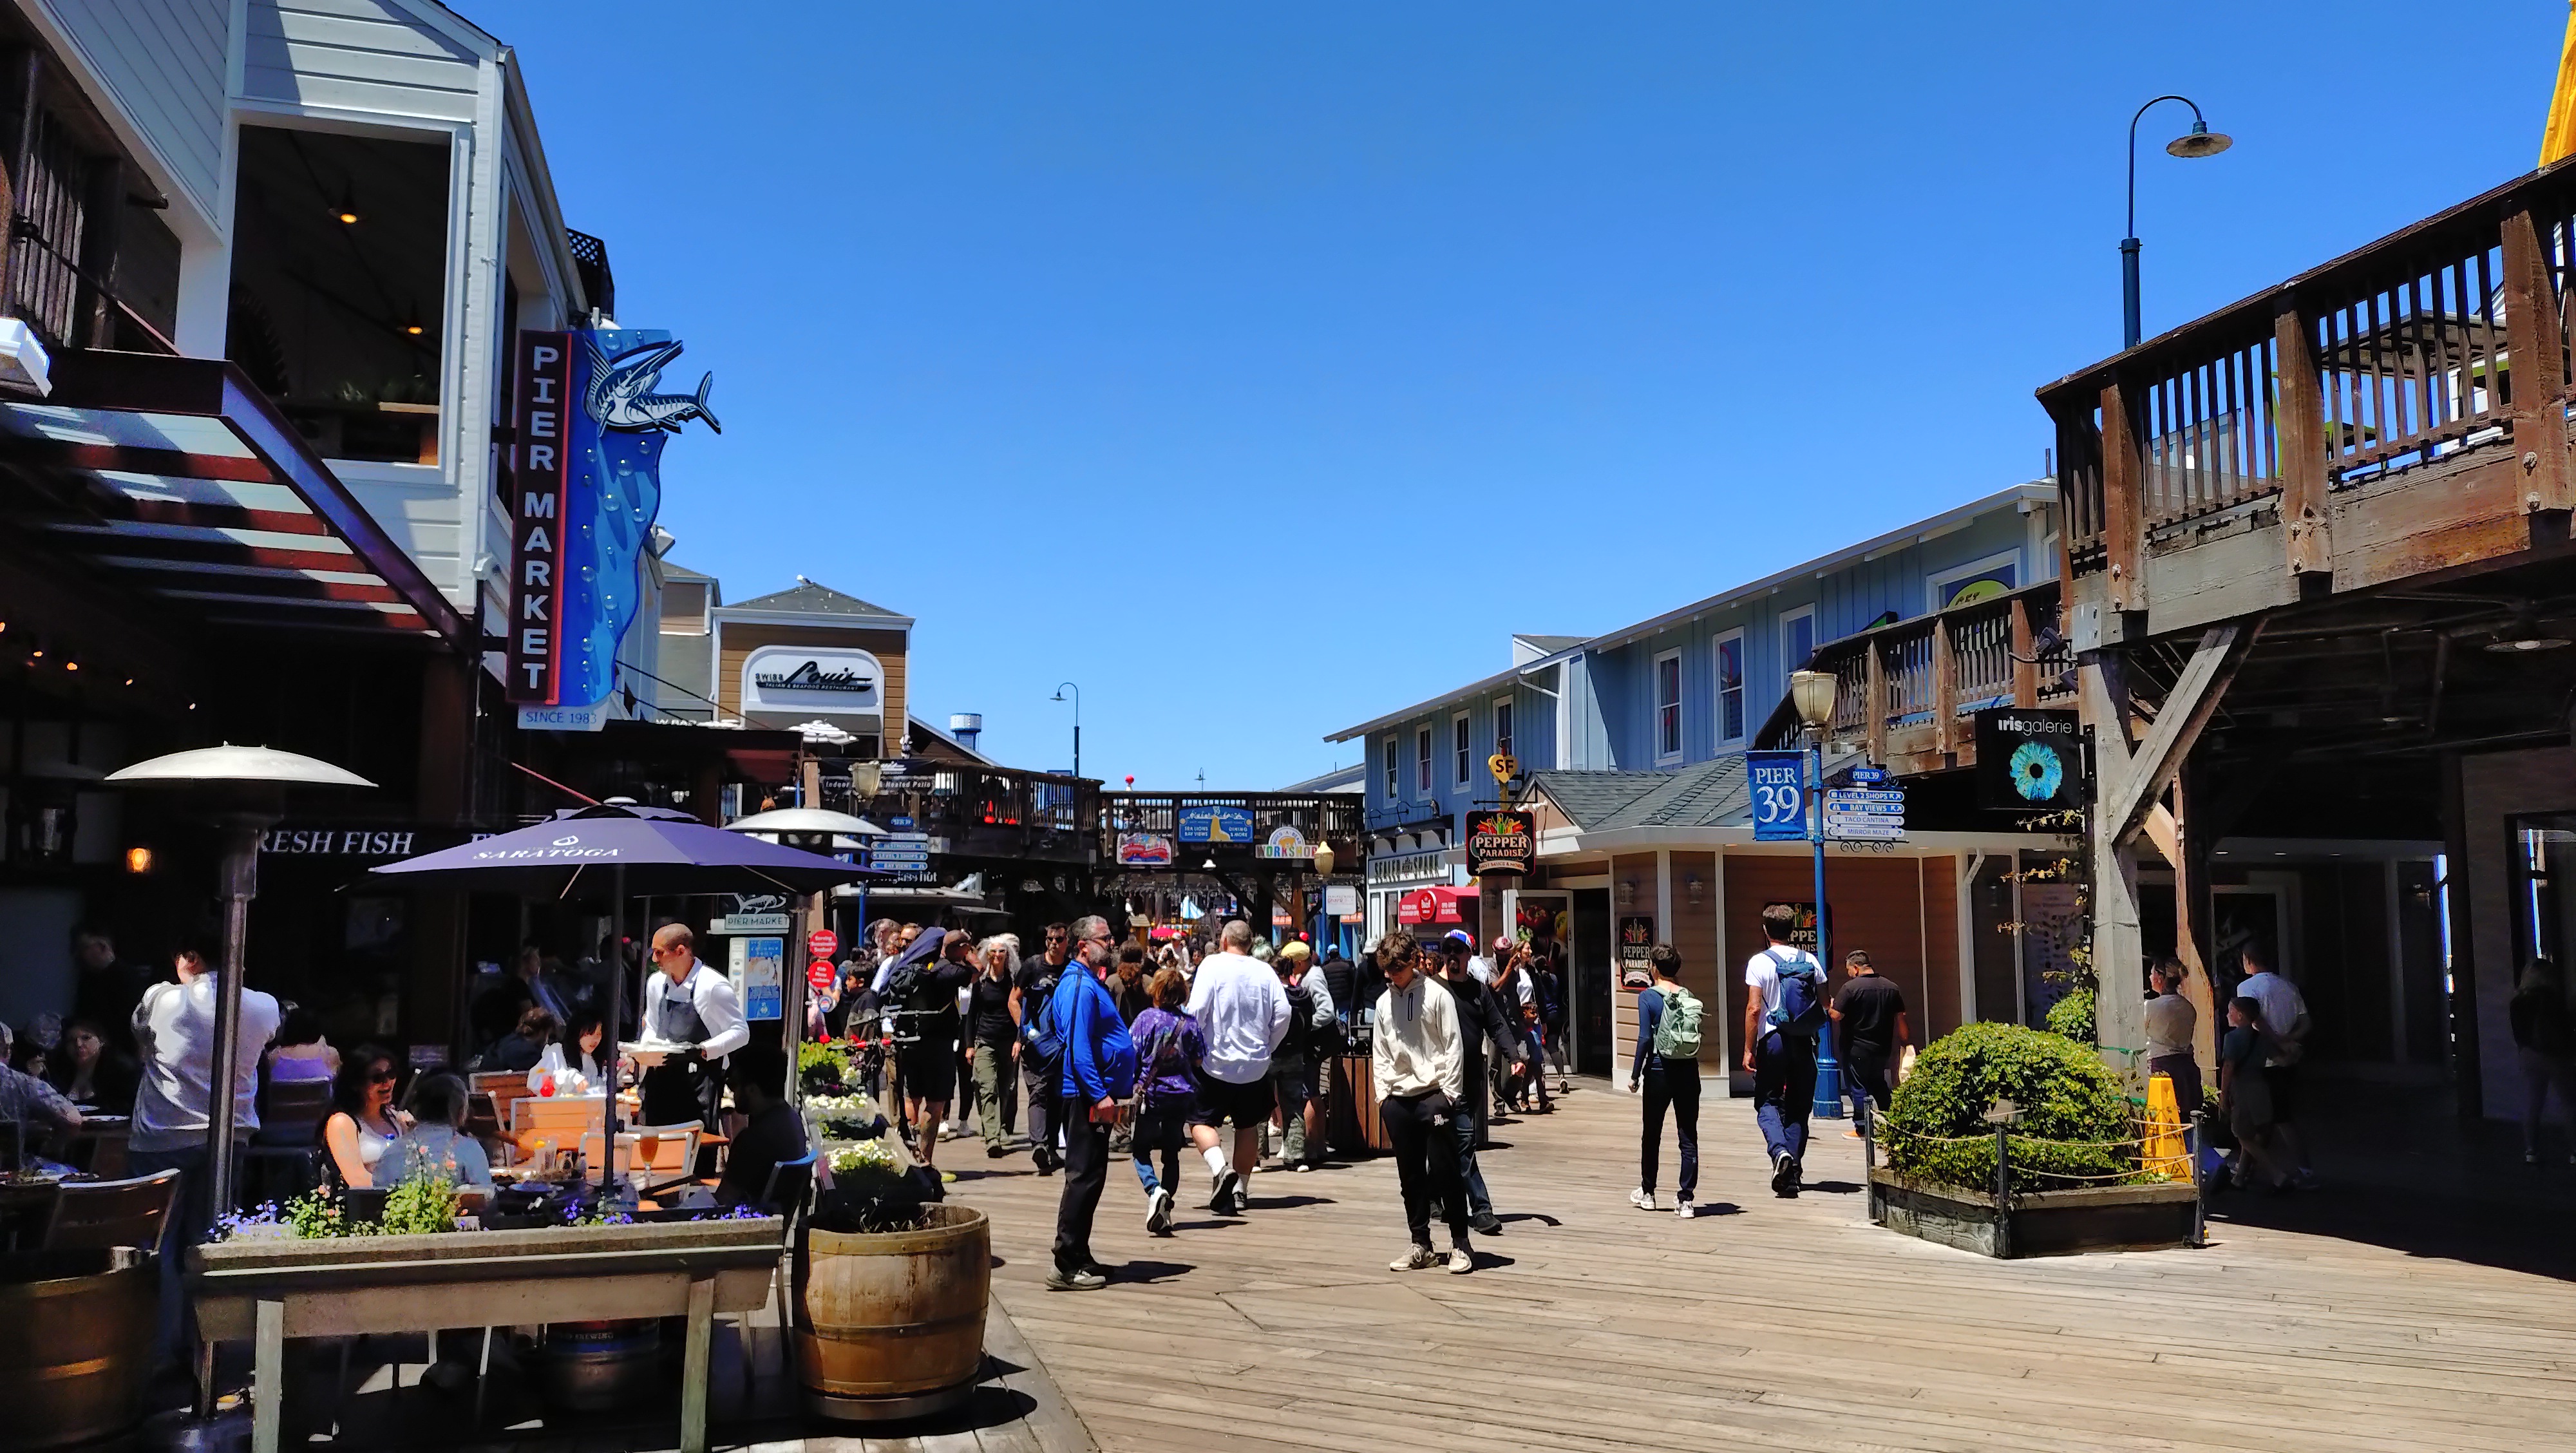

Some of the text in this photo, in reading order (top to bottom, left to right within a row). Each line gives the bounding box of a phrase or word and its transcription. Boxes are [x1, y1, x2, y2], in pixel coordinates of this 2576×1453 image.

[522, 346, 559, 690] PIER MARKET
[755, 661, 872, 684] SWISS Louis
[526, 712, 597, 724] SINCE 1983
[1755, 767, 1797, 784] PIER
[1853, 771, 1880, 780] PIER 39
[1757, 785, 1800, 823] 39
[257, 830, 415, 855] RESH FISH
[1475, 837, 1528, 848] PEPPER
[473, 848, 619, 860] SARATOGA
[1256, 846, 1318, 858] WORKSHOP
[1479, 848, 1524, 857] PARADISE
[728, 916, 790, 926] PIER MARKET
[1623, 945, 1650, 958] PEPPER
[1625, 959, 1649, 969] PARADISE
